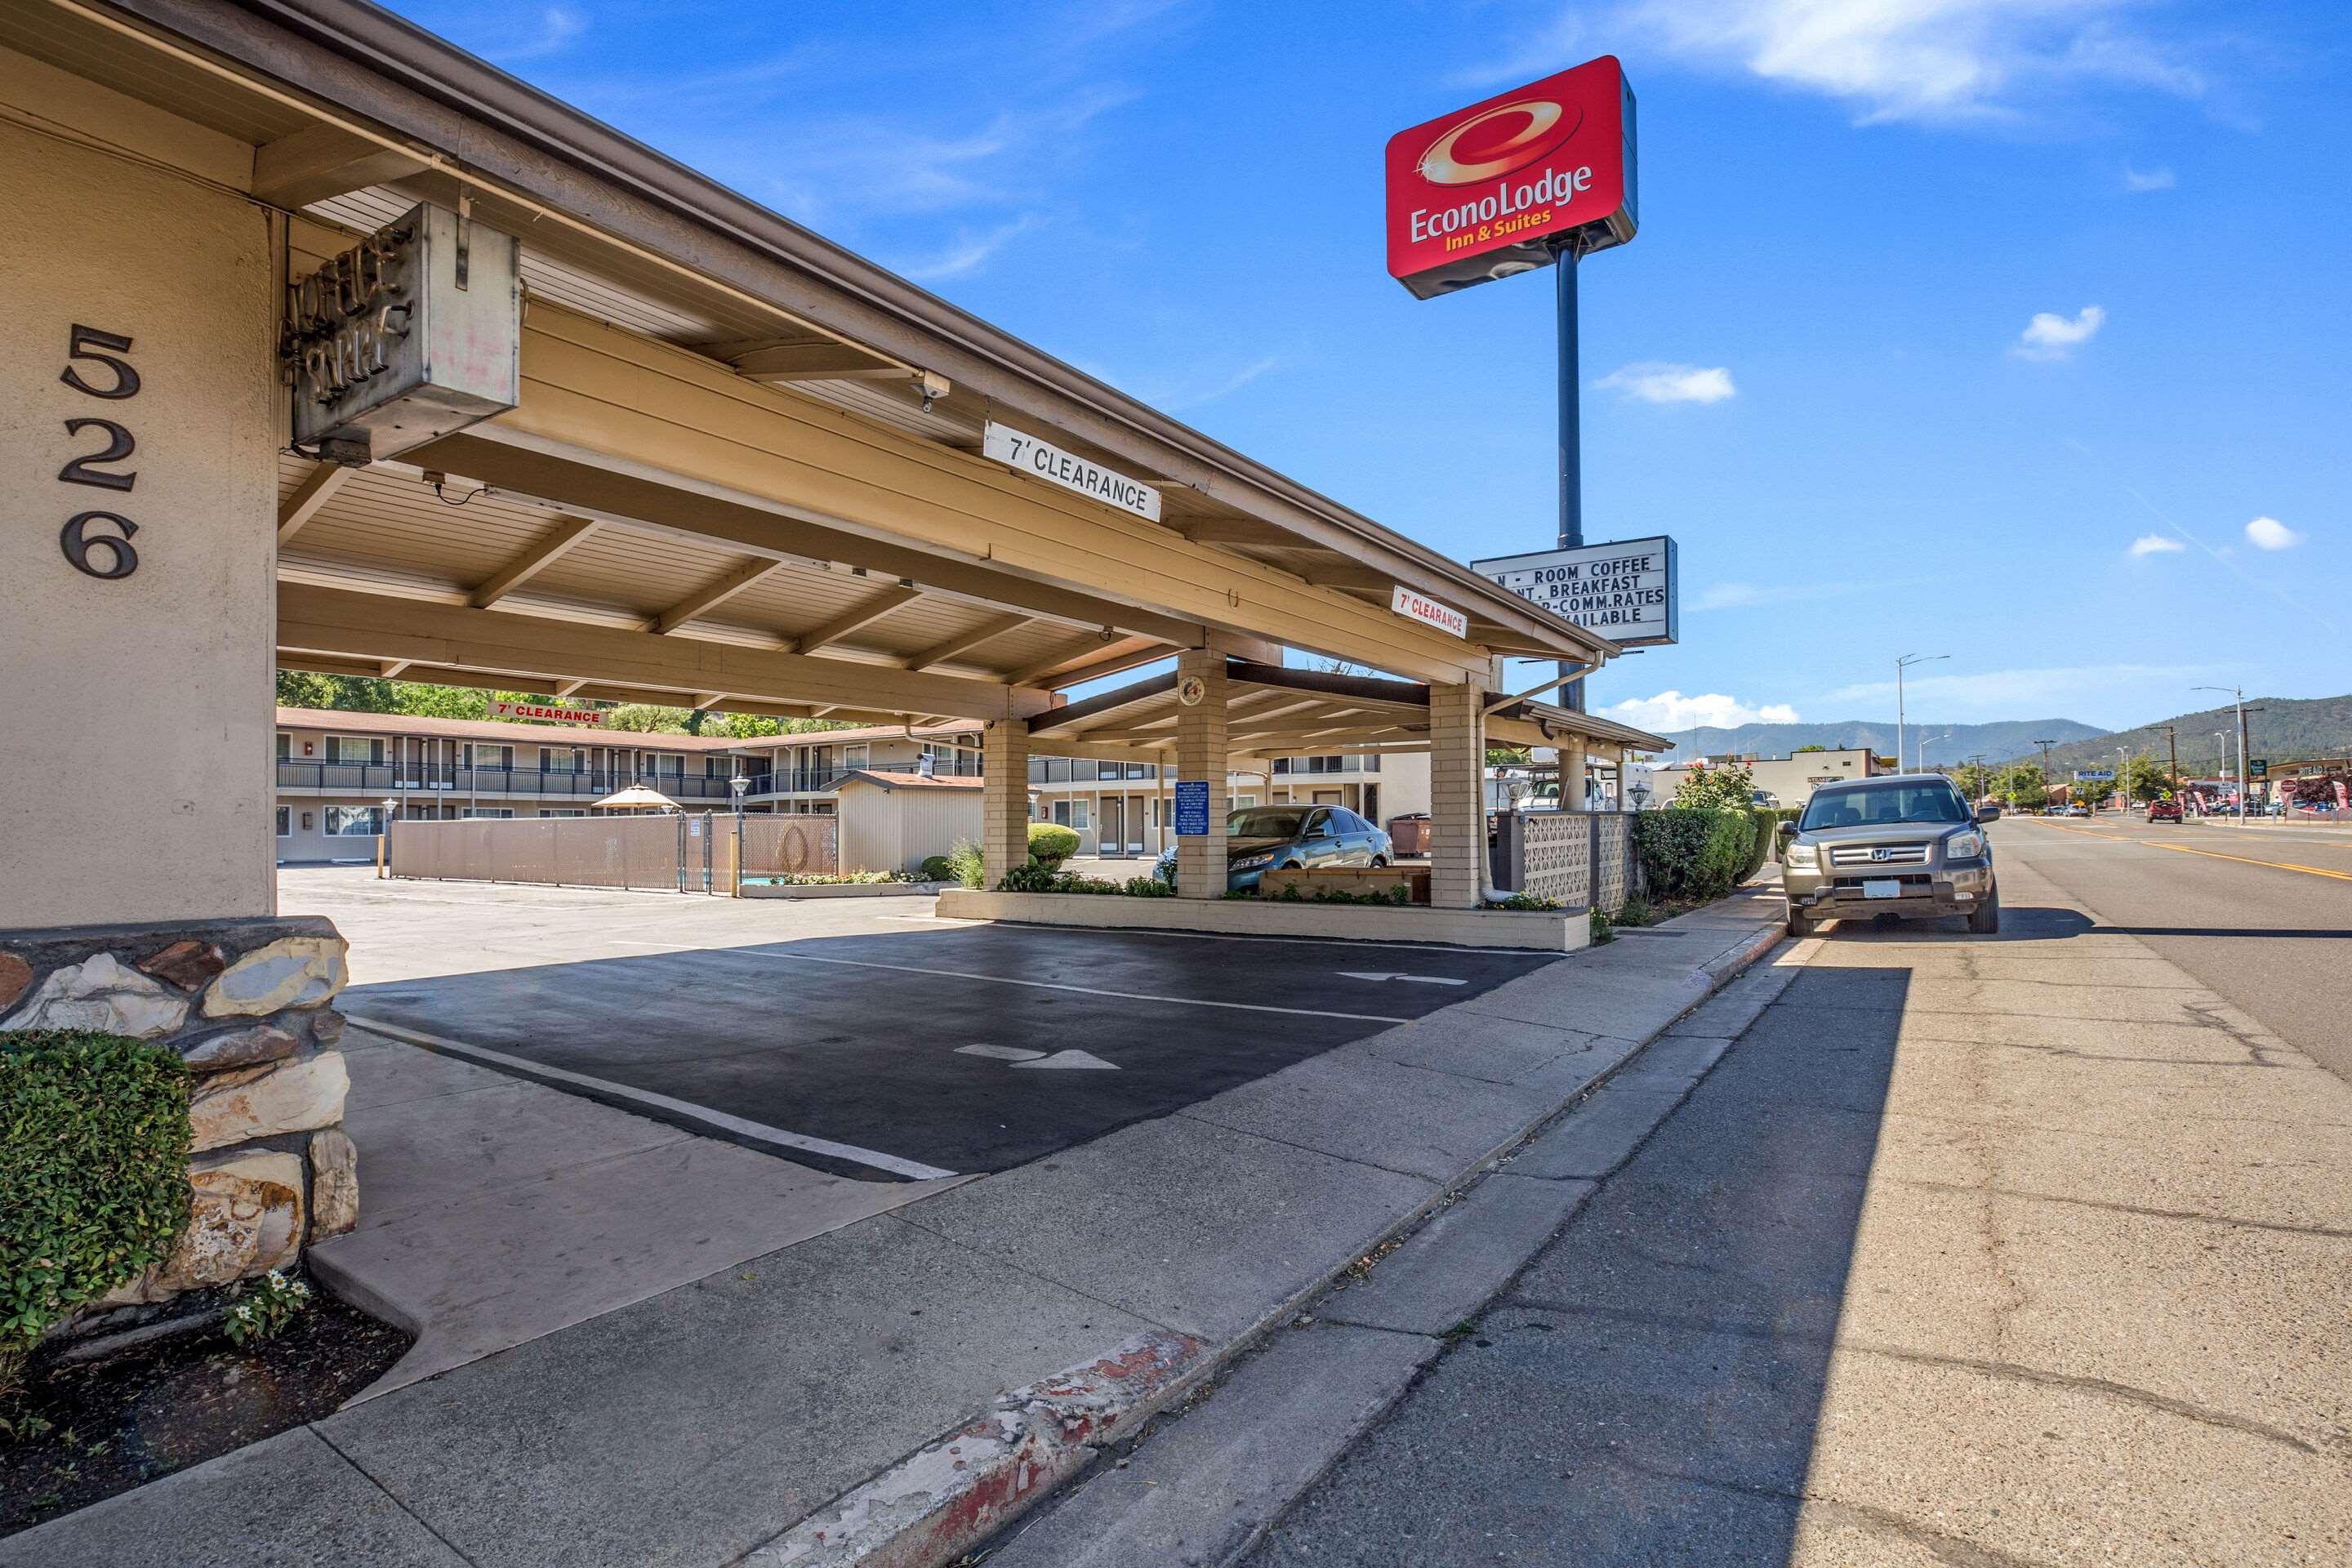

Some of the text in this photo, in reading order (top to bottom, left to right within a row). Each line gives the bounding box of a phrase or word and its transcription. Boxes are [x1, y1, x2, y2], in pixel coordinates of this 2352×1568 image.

[1410, 166, 1592, 243] EconoLodge
[1446, 210, 1552, 252] Inn & Suites
[58, 323, 140, 580] 526
[1010, 438, 1147, 510] 7' CLEARANCE
[1535, 566, 1579, 583] ROOM
[1591, 557, 1650, 576] COFFEE
[1550, 575, 1640, 597] BREAKFAST
[1400, 594, 1463, 632] 7' CLEARANCE
[498, 704, 600, 723] 7' CLEARANCE
